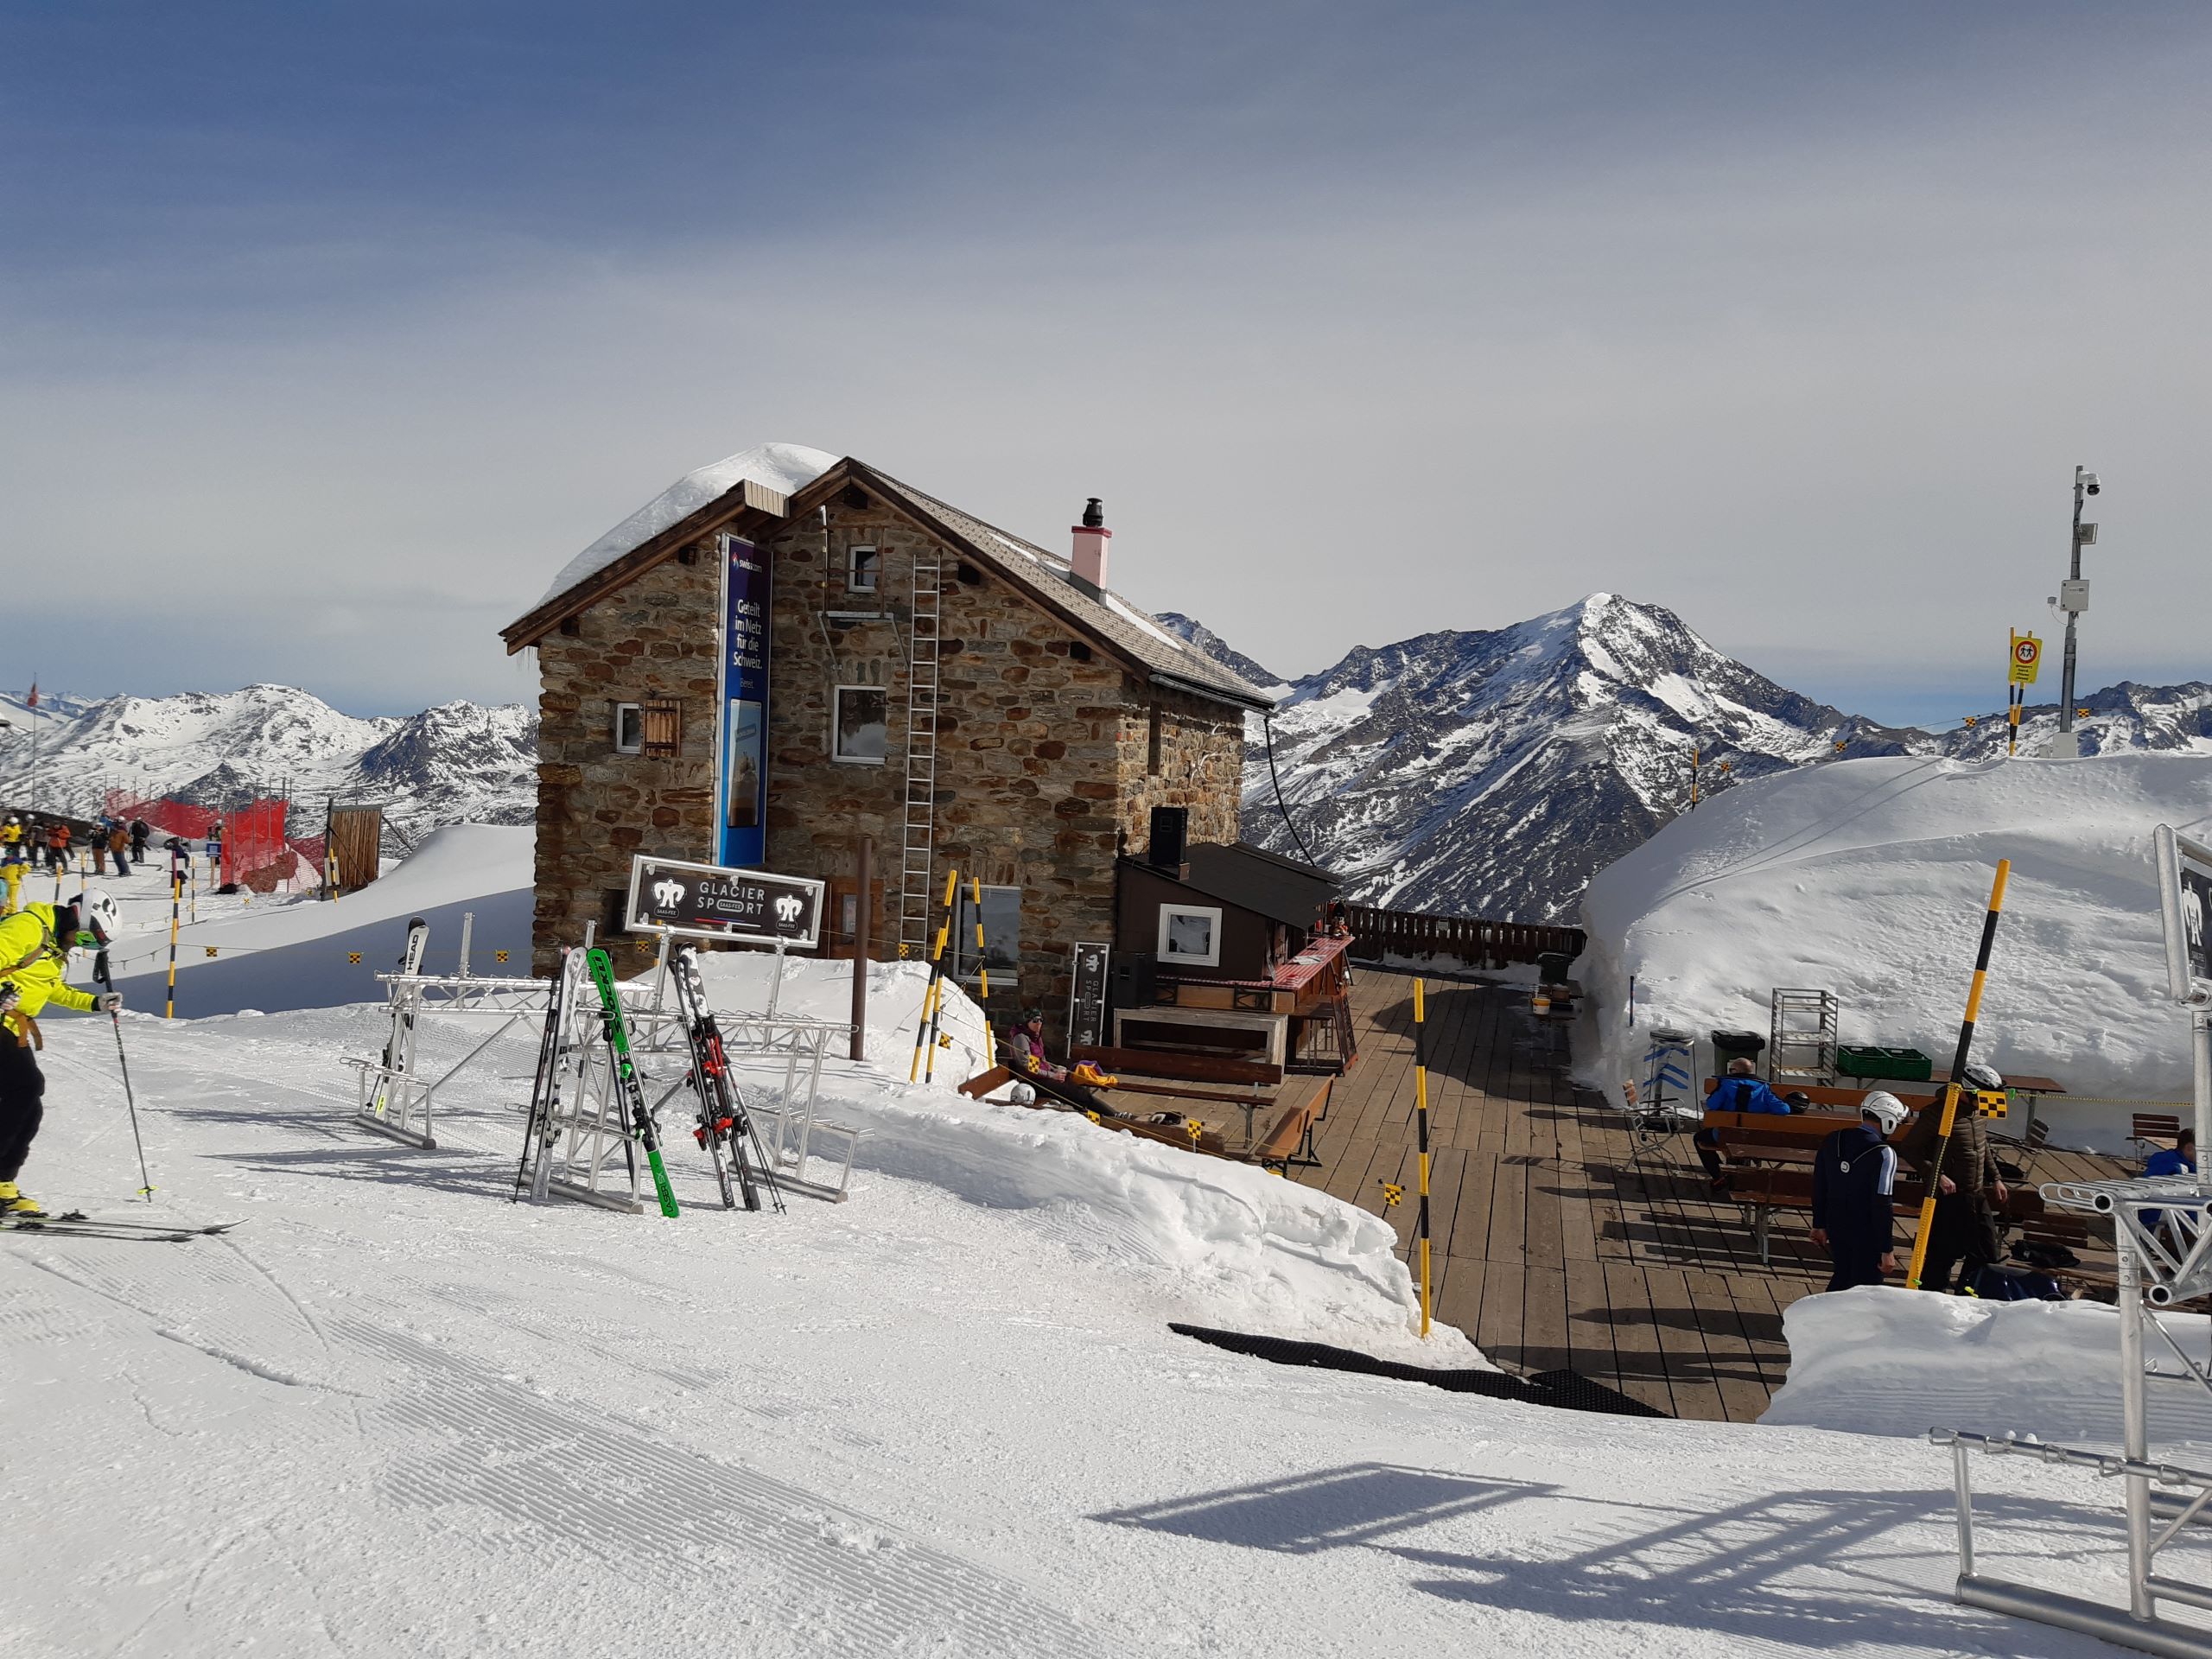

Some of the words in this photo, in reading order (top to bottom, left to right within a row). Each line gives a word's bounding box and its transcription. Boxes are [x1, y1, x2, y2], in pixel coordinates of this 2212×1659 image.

[739, 558, 762, 573] swisscom
[737, 599, 760, 617] Geteilt
[734, 615, 744, 631] im
[746, 619, 761, 634] Netz
[737, 633, 747, 649] für
[748, 638, 759, 652] die
[734, 652, 762, 669] Schweiz.
[699, 881, 766, 900] GLACIER
[406, 934, 419, 970] HEAD
[661, 1185, 673, 1213] LASER
